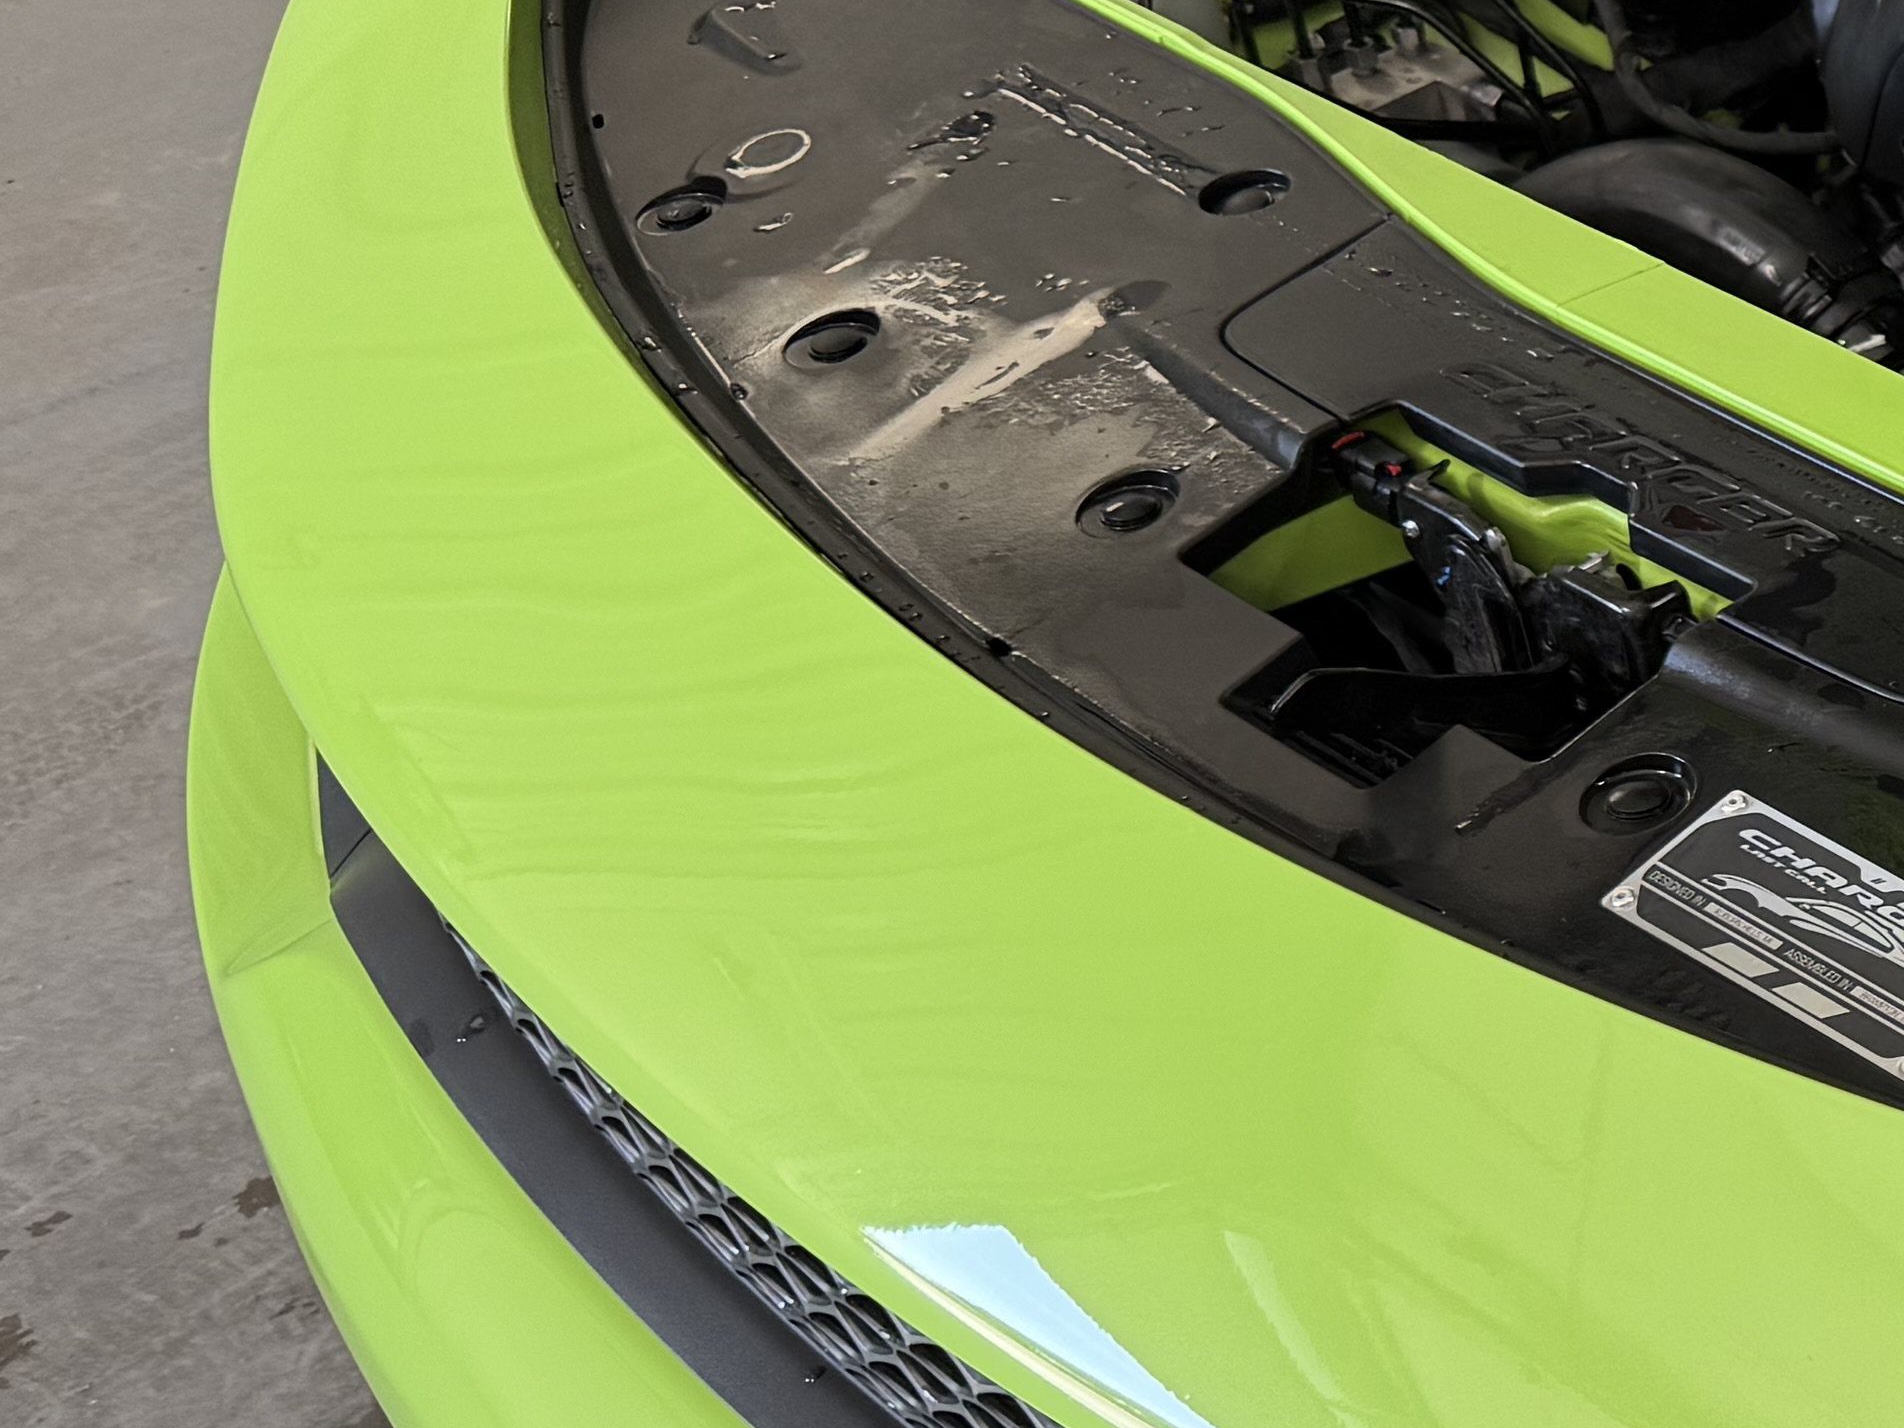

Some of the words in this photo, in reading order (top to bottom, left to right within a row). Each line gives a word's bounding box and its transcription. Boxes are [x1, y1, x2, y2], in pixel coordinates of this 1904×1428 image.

[1442, 363, 1842, 556] CHARGER
[1647, 870, 1697, 901] DESIGNED
[1689, 894, 1707, 907] IN
[1739, 842, 1785, 870] LAST
[1782, 867, 1829, 895] CALL
[1782, 947, 1844, 986] ASSEMBLED
[1836, 979, 1853, 991] IN
